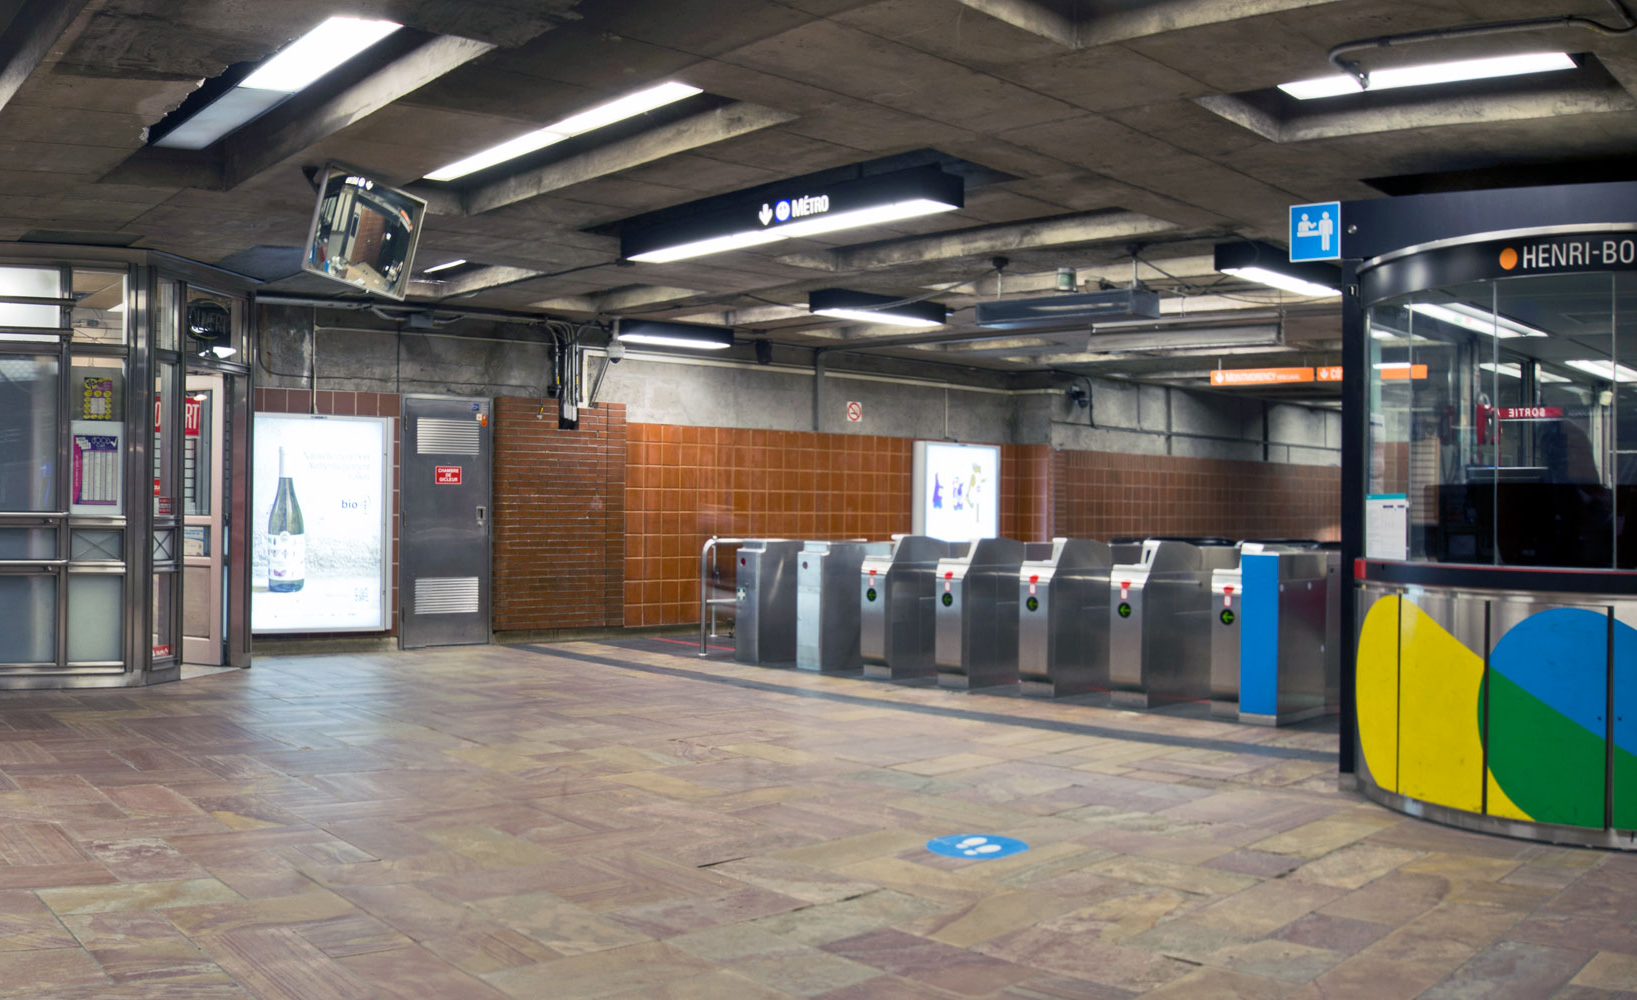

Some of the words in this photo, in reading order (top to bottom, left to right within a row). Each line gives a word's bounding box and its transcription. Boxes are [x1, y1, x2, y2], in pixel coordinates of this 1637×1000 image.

[792, 195, 829, 217] MÉTRO
[1523, 240, 1635, 269] HENRI-BO
[155, 401, 200, 430] ORT
[341, 499, 358, 509] bio
